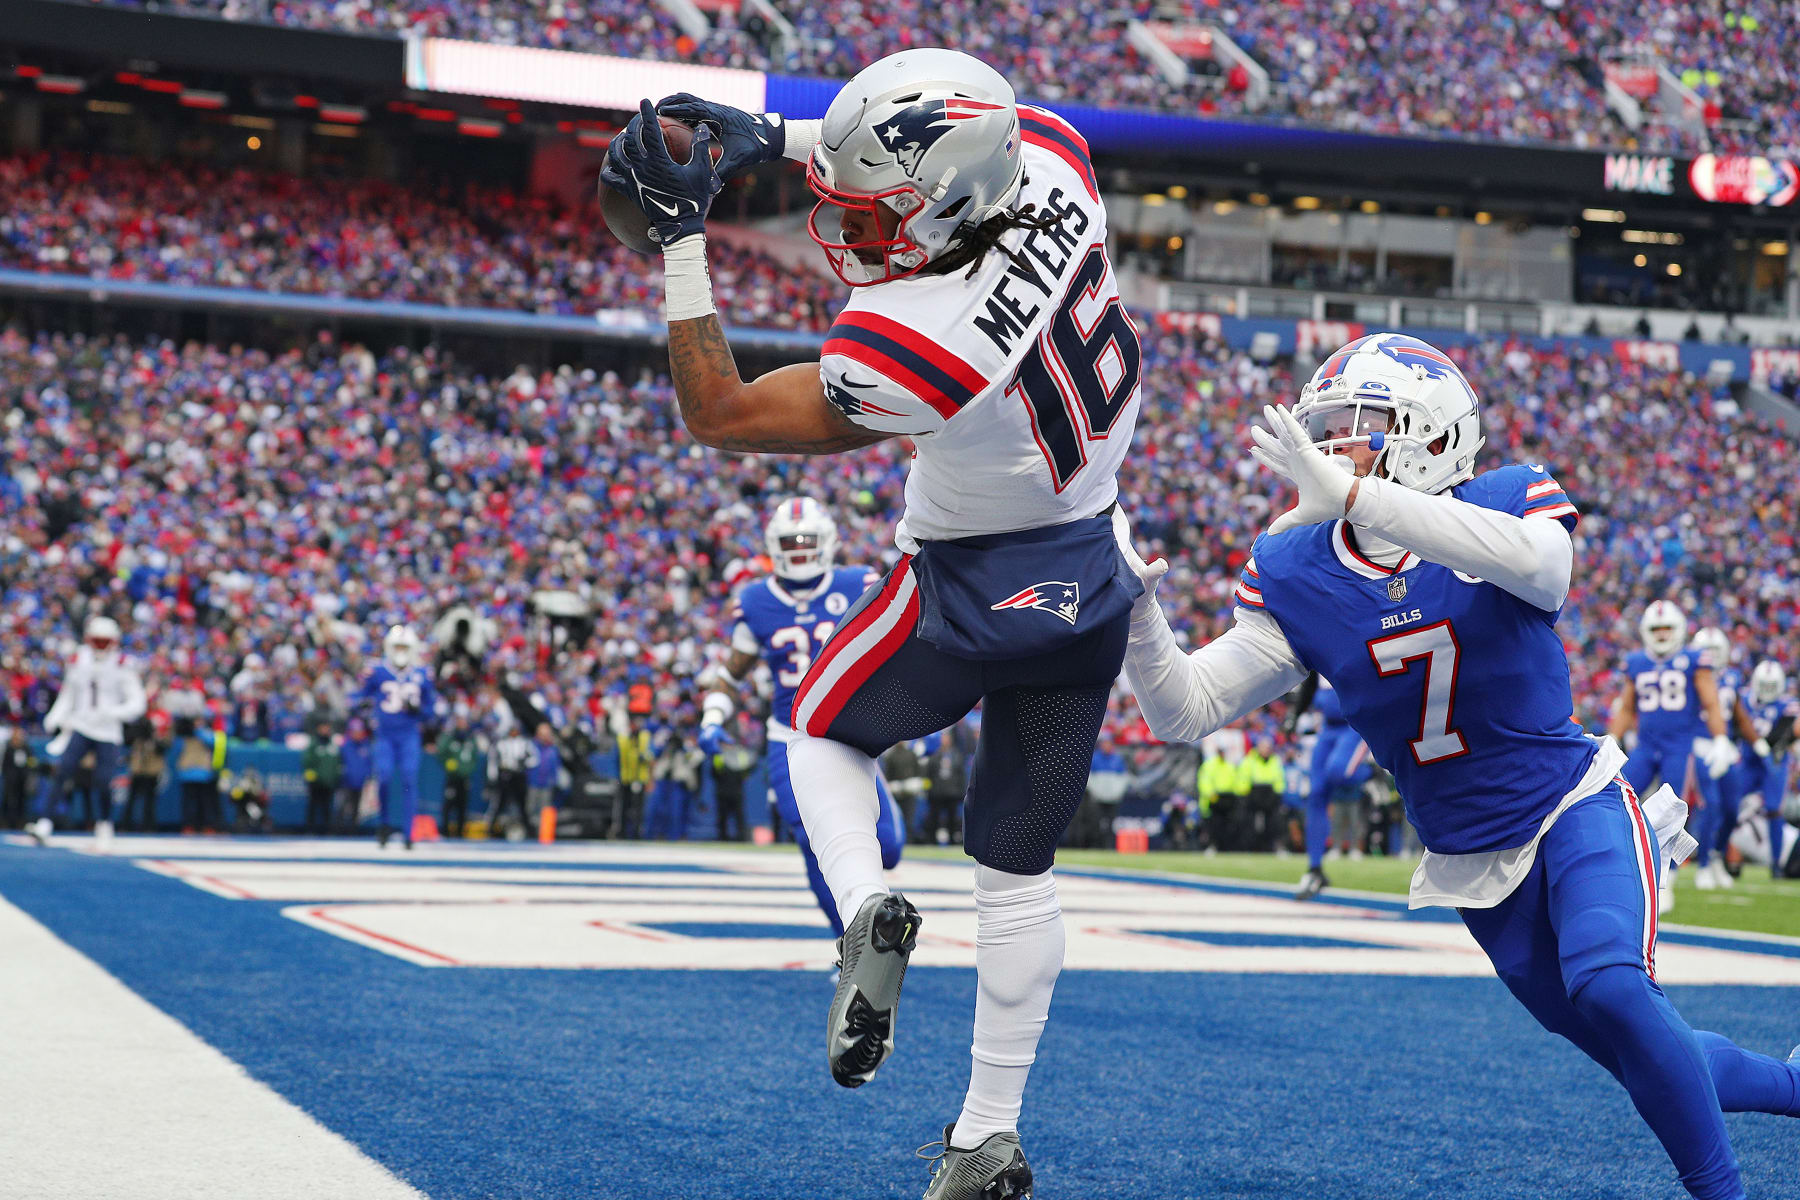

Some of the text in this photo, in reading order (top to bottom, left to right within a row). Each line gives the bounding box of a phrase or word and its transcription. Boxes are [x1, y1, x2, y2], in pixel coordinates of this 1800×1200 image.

[1604, 154, 1675, 195] MAKE
[973, 187, 1089, 358] MEYERS
[1004, 243, 1142, 495] 16
[1380, 608, 1422, 630] BILLS
[1366, 618, 1472, 766] 7
[1635, 669, 1687, 712] 58
